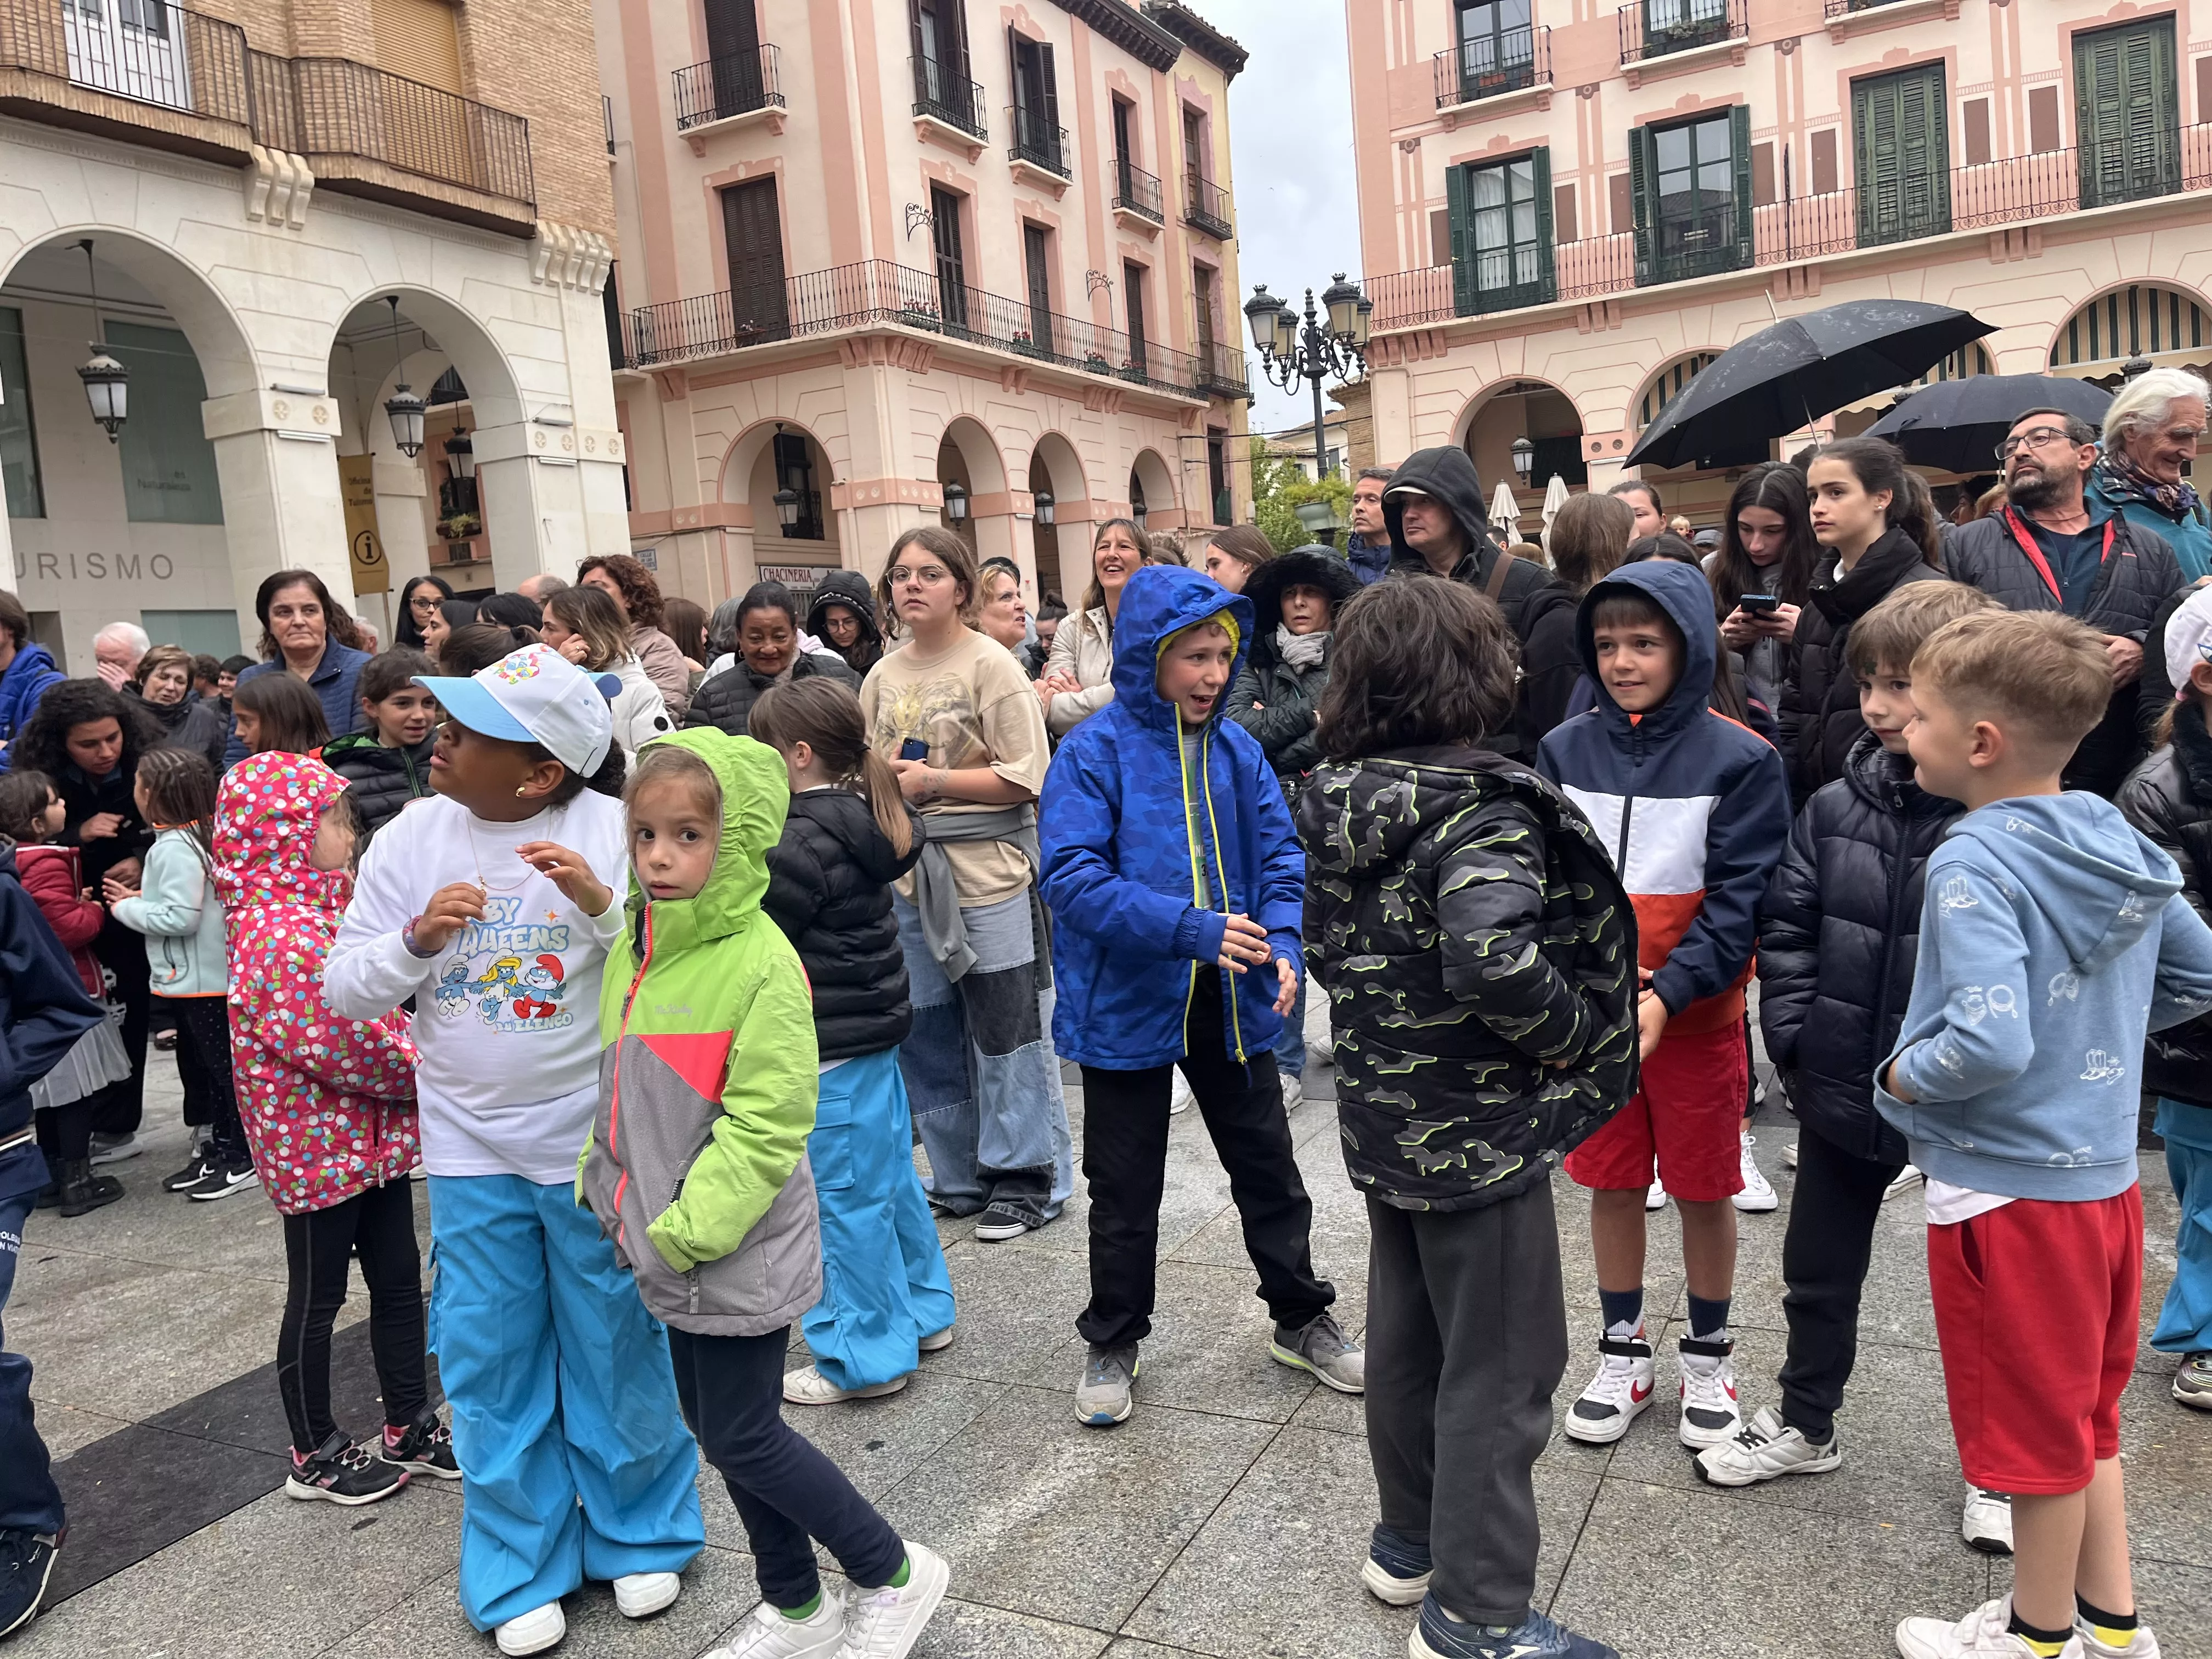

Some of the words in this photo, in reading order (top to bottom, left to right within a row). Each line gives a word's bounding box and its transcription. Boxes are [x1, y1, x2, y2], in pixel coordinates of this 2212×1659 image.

[764, 568, 812, 583] CHACINERIA
[466, 898, 522, 926] BY
[457, 924, 569, 959] QUEENS
[513, 1013, 573, 1033] ELENCO
